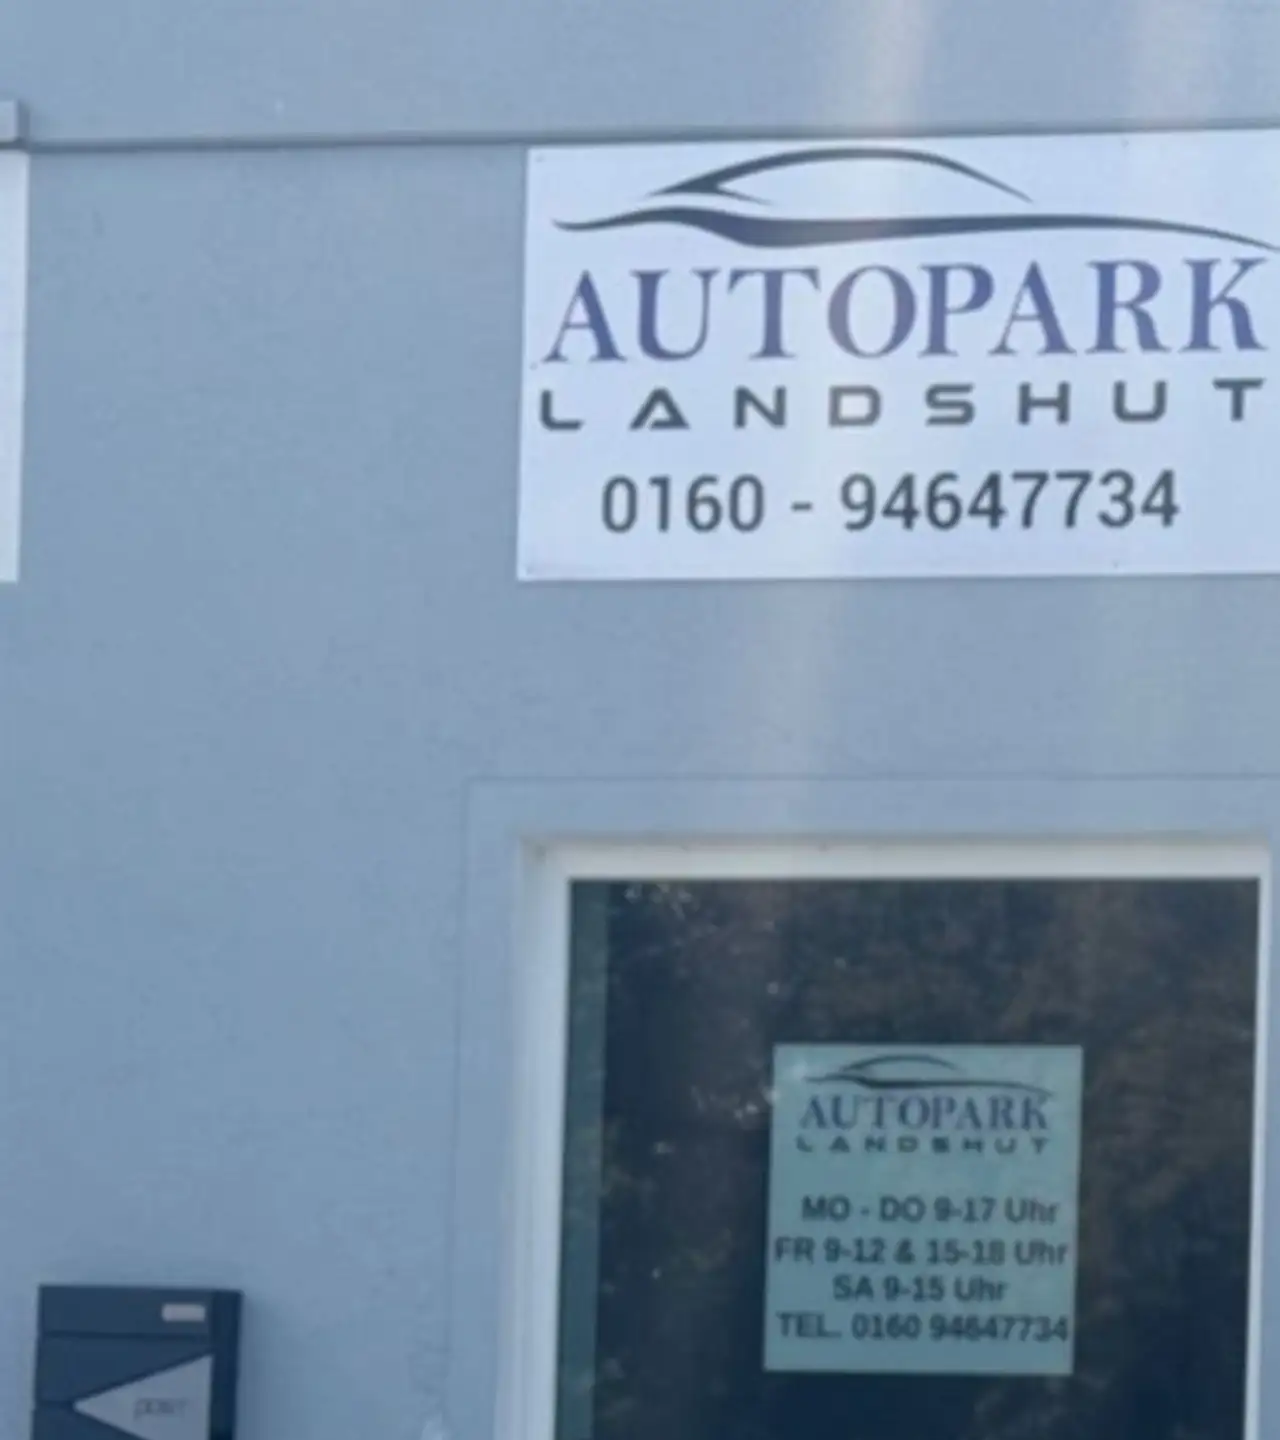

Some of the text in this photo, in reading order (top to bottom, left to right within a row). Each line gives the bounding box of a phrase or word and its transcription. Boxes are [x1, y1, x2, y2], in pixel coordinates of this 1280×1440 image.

[541, 257, 1268, 364] AUTOPARK
[539, 378, 1266, 431] LANDSHUT
[601, 469, 1180, 533] 0160 - 94647734
[800, 1095, 1049, 1131] AUTOPARK
[795, 1135, 1050, 1154] LANDSHUT
[802, 1195, 850, 1222] MO
[879, 1196, 926, 1222] DO
[933, 1196, 997, 1222] 9-17
[1003, 1196, 1060, 1223] Uhr
[774, 1236, 1069, 1267] FR 9-12 & 15-18 Uhr
[832, 1273, 1009, 1301] SA 9-15 Uhr
[775, 1311, 1069, 1341] TEL. 0160 94647734
